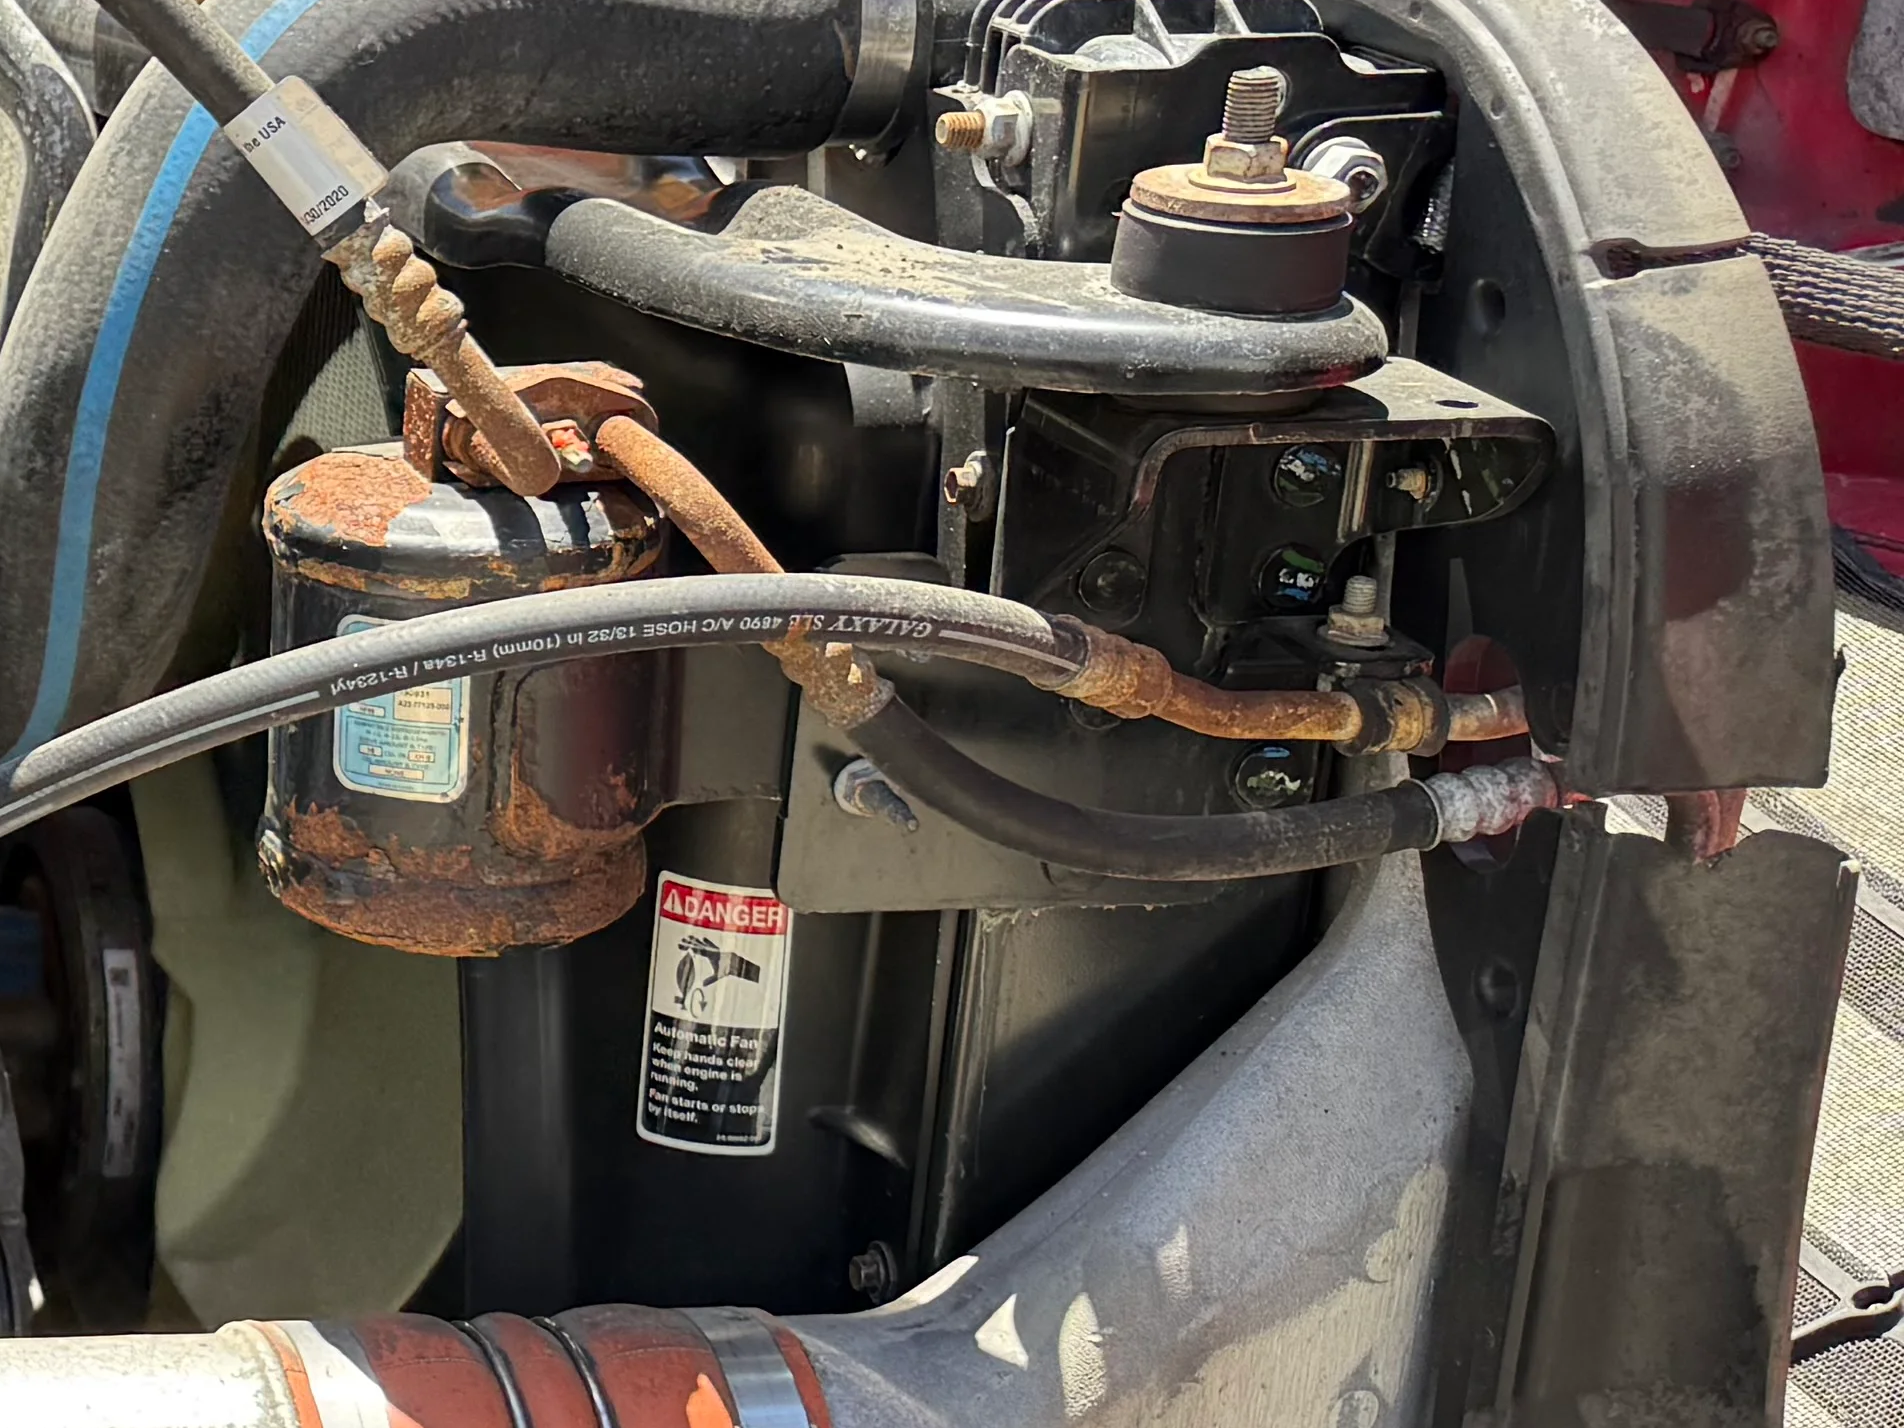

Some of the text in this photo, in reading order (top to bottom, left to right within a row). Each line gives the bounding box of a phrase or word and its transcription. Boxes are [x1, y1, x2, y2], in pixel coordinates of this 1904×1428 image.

[257, 115, 287, 141] USA
[587, 624, 636, 643] 13/32
[642, 618, 697, 638] HOSE
[701, 617, 735, 633] A/C
[740, 615, 783, 631] 4890
[828, 614, 933, 639] GALAXY
[492, 633, 561, 660] (10mm)
[423, 648, 487, 672] R-134a
[329, 664, 409, 698] R-1234yf
[684, 899, 784, 928] DANGER
[654, 1021, 758, 1049] Automatic Fan
[653, 1042, 759, 1069] Keep hands clear
[650, 1071, 699, 1093] running.
[652, 1058, 742, 1082] when engine is
[648, 1101, 699, 1124] by itself.
[649, 1088, 670, 1104] Fan
[672, 1095, 709, 1112] starts
[712, 1102, 726, 1114] or
